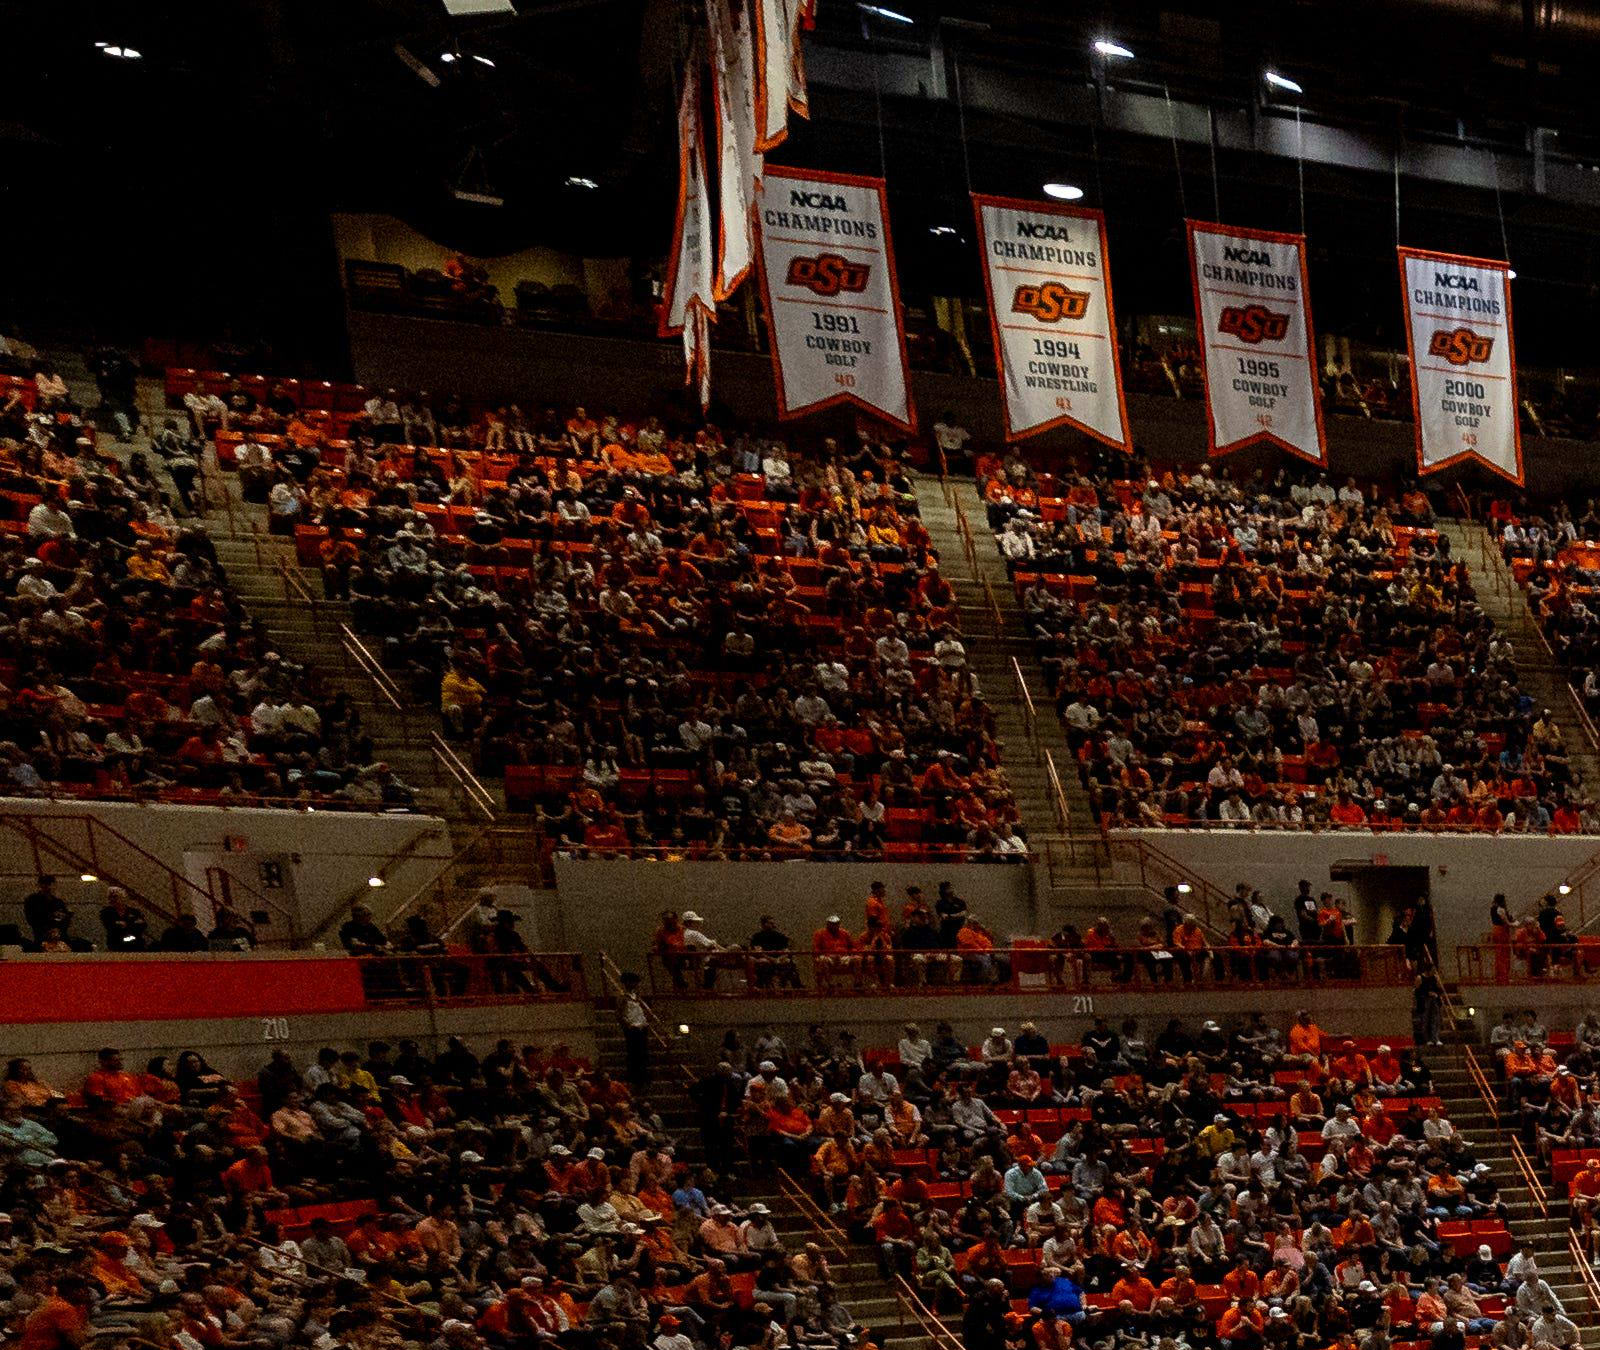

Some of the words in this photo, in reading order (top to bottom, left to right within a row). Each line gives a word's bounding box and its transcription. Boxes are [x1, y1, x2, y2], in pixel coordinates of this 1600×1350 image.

[790, 189, 848, 213] NCAA
[765, 210, 878, 239] CHAMPIONS
[1017, 221, 1069, 242] NCAA
[993, 241, 1097, 268] CHAMPIONS
[1223, 246, 1271, 268] NCAA
[785, 252, 872, 297] OSU
[1202, 264, 1298, 291] CHAMPIONS
[1435, 272, 1479, 291] NCAA
[1011, 281, 1090, 323] OSU
[1415, 289, 1501, 315] CHAMPIONS
[812, 312, 861, 334] 1991
[1218, 304, 1290, 345] OSU
[806, 336, 871, 354] COWBOY
[1033, 338, 1081, 359] 1994
[1427, 327, 1495, 365] OSU
[825, 353, 857, 368] GOLF
[1028, 361, 1088, 379] COWBOY
[1237, 358, 1279, 379] 1995
[1025, 376, 1098, 393] WRESTLING
[1233, 379, 1288, 397] COWBOY
[1445, 379, 1485, 399] 2000
[1248, 395, 1275, 409] GOLF
[1441, 400, 1492, 417] COWBOY
[1454, 415, 1480, 429] GOLF
[1072, 995, 1094, 1013] 211
[261, 1017, 289, 1040] 210
